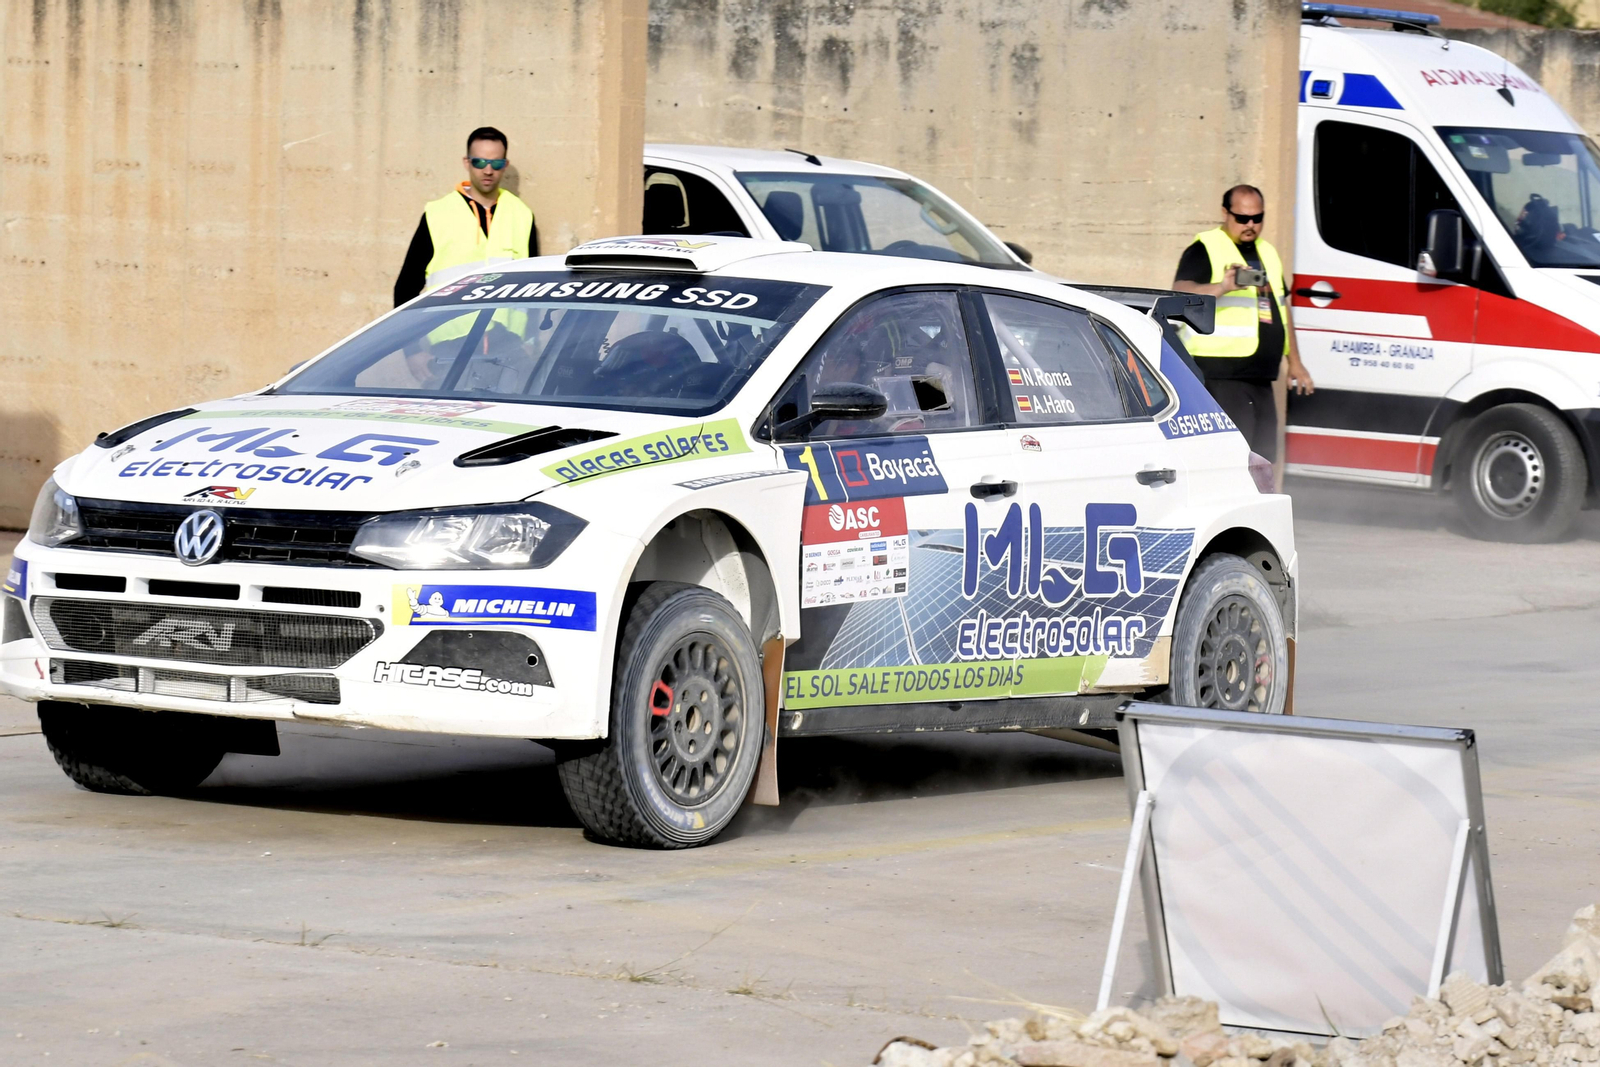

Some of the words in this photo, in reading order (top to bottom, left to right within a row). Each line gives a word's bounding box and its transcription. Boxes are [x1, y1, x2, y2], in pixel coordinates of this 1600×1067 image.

[461, 282, 669, 301] SAMSUNG
[671, 287, 758, 310] SSD
[1331, 340, 1381, 356] ALHAMBRA
[1389, 343, 1434, 360] GRANADA
[1363, 358, 1378, 368] 958
[1380, 360, 1391, 369] 40
[1021, 367, 1073, 388] N.Roma
[1033, 393, 1076, 415] A.Haro
[1177, 414, 1201, 435] 654
[1198, 413, 1214, 432] 85
[798, 445, 829, 501] 1
[865, 450, 939, 485] Boyacá
[183, 485, 257, 501] ARV
[845, 506, 881, 530] ASC
[451, 598, 576, 618] MICHELIN
[132, 617, 236, 652] ARV
[786, 676, 805, 699] EL
[810, 674, 843, 696] SOL
[847, 672, 889, 695] SALE
[893, 668, 950, 693] TODOS
[953, 666, 985, 688] LOS
[987, 664, 1024, 687] DIAS
